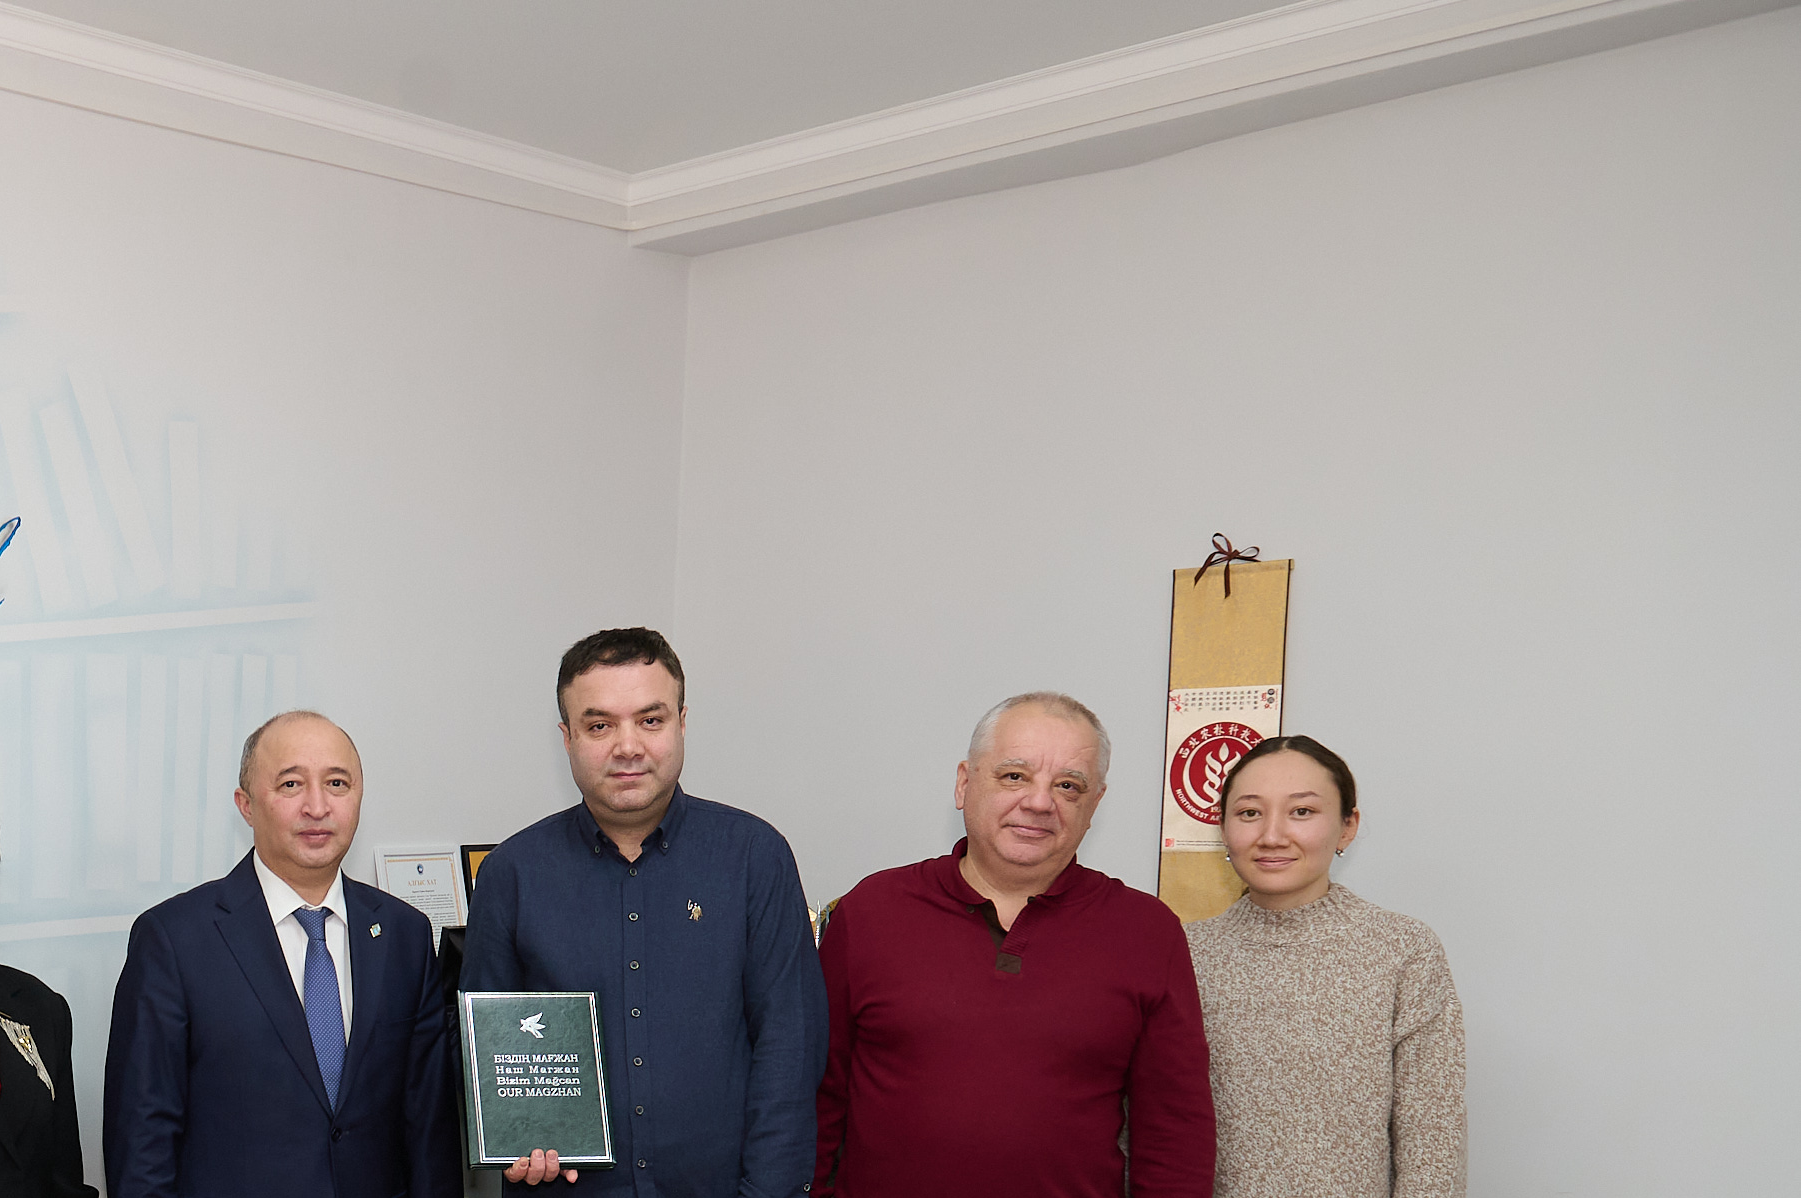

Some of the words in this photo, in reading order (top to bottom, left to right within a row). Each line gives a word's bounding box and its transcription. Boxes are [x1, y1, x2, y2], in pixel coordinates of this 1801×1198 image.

[1175, 788, 1209, 820] NORTHWEST
[493, 1054, 531, 1064] БІЗДІҢ
[532, 1054, 579, 1063] МАҒЖАН
[495, 1065, 524, 1074] Наш
[529, 1065, 579, 1074] Магжан
[496, 1076, 531, 1085] Bizim
[497, 1087, 524, 1097] OUR
[525, 1087, 582, 1097] MAGZHAN
